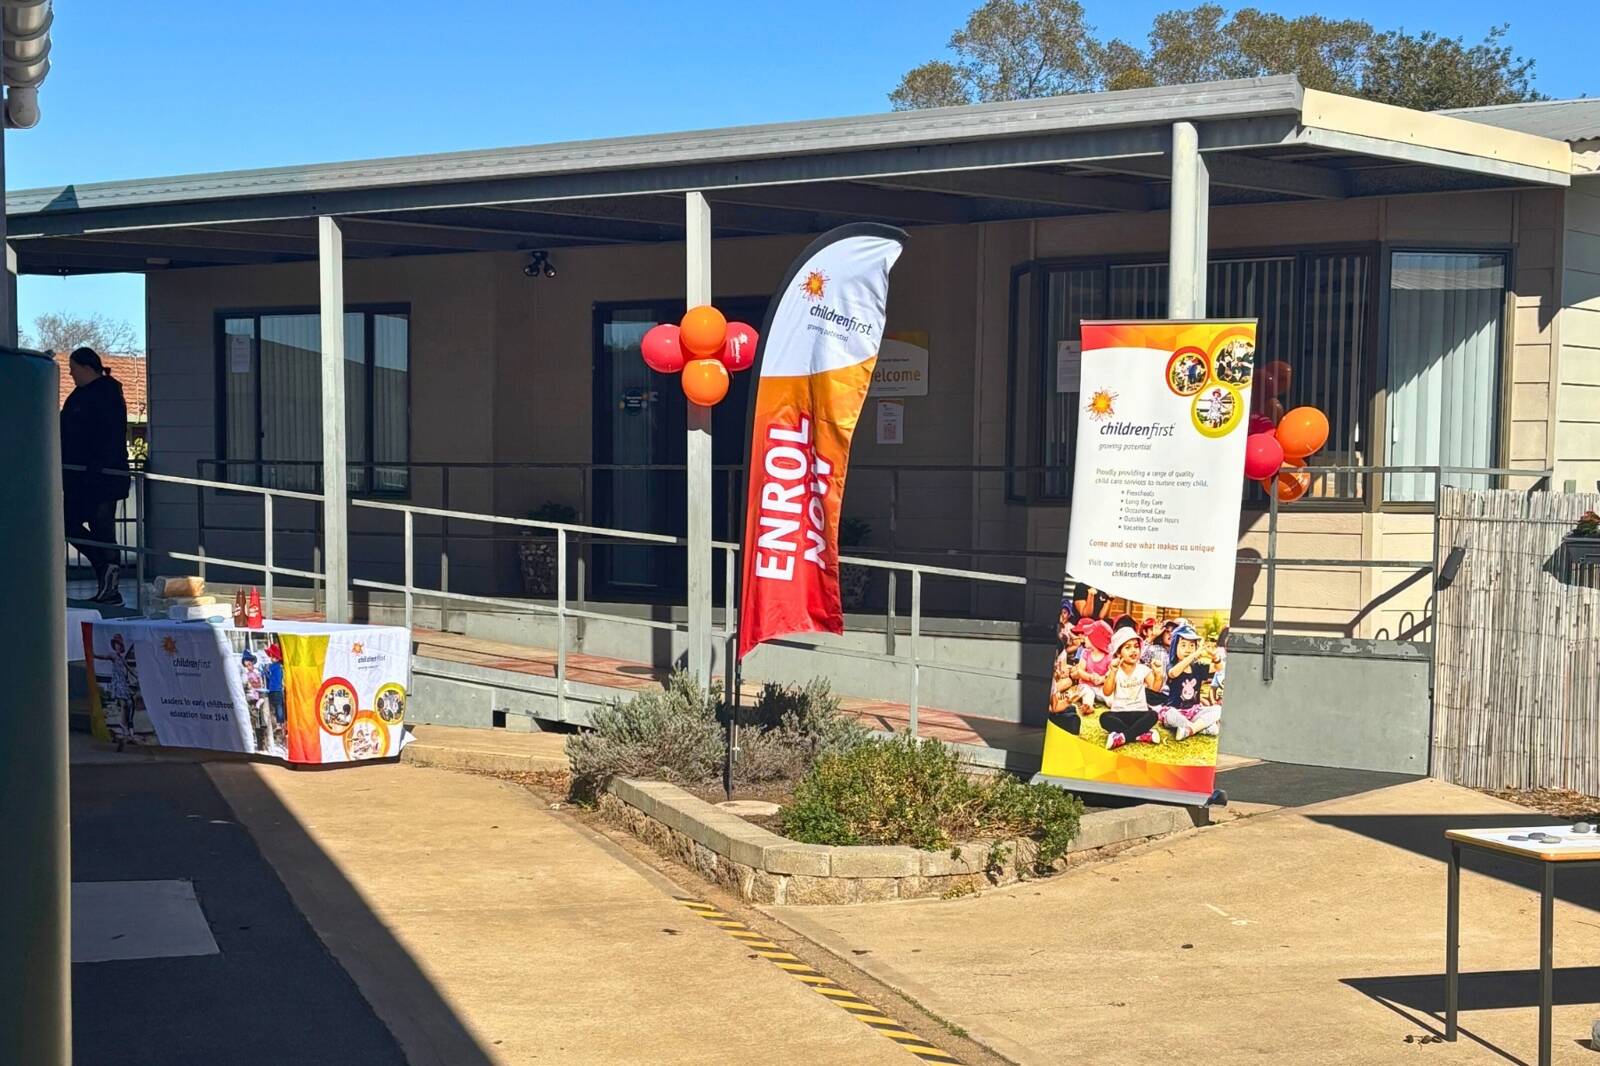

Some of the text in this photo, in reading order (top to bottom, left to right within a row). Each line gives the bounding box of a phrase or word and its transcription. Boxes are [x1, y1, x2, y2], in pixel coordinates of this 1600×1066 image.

[809, 304, 873, 336] childrenfirst
[873, 367, 921, 383] elcome
[1100, 422, 1175, 439] childrenfirst
[1098, 443, 1152, 451] growing potential
[1096, 468, 1117, 477] Proudly
[1118, 469, 1146, 478] providing
[1175, 470, 1194, 479] quality
[1192, 480, 1208, 488] child.
[755, 416, 810, 582] ENROL
[1089, 539, 1108, 548] Come
[1110, 540, 1124, 548] and
[1138, 541, 1156, 550] what
[1157, 542, 1179, 551] makes
[1190, 544, 1215, 554] unique
[1115, 560, 1138, 568] website
[1140, 561, 1148, 569] for
[1149, 562, 1168, 570] centre
[1168, 562, 1196, 571] locations
[160, 696, 184, 705] Leaders
